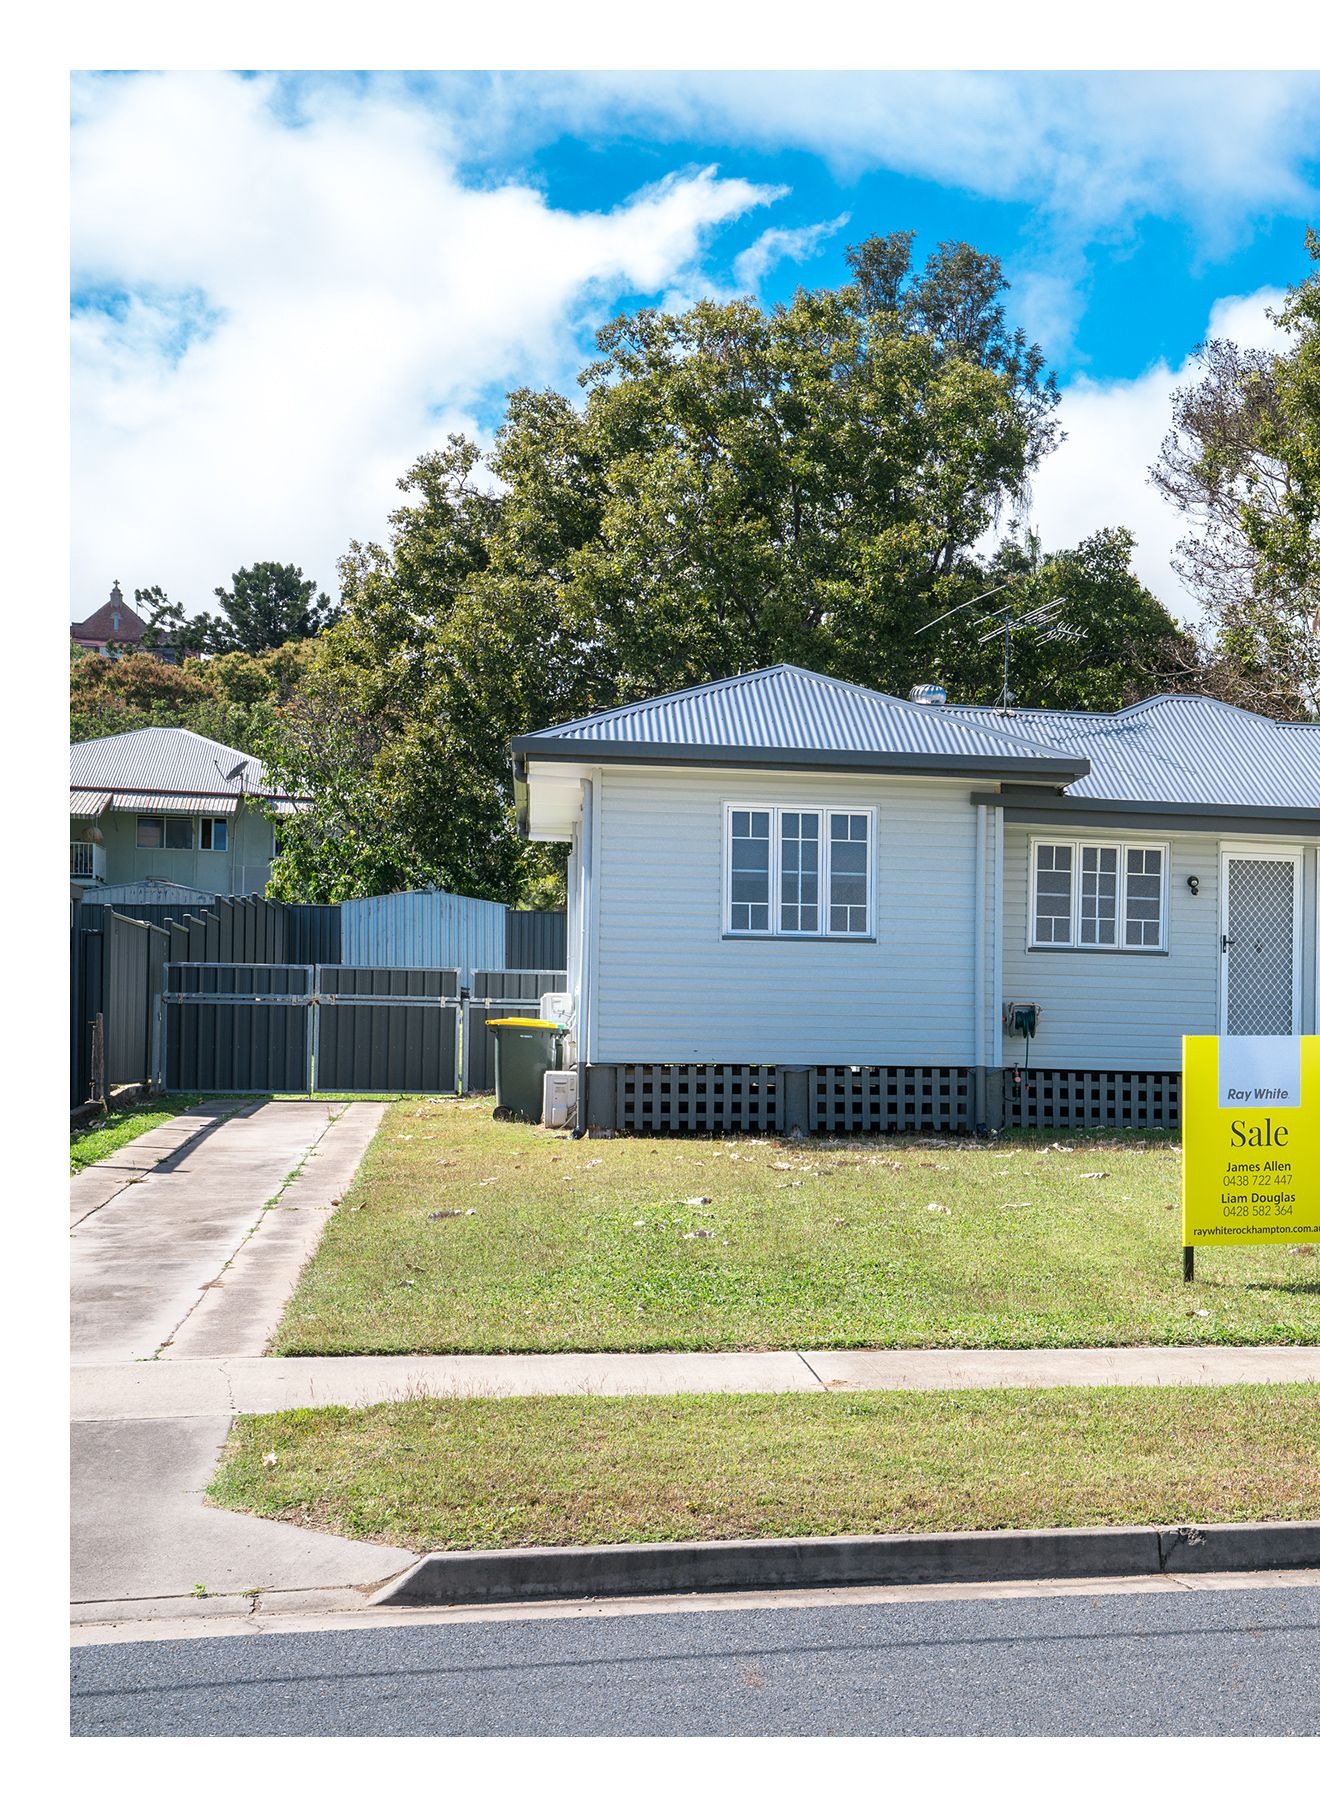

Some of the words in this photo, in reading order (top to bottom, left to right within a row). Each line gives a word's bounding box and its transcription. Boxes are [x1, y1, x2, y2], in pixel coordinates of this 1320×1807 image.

[1227, 1088, 1252, 1102] Ray
[1254, 1088, 1289, 1100] White
[1231, 1117, 1289, 1148] Sale
[1226, 1161, 1261, 1172] James
[1263, 1160, 1291, 1171] Allen
[1223, 1175, 1249, 1186] 0438
[1252, 1174, 1271, 1186] 722
[1273, 1174, 1293, 1185] 447
[1221, 1193, 1248, 1204] Liam
[1251, 1192, 1296, 1205] Douglas
[1223, 1206, 1249, 1217] 0428
[1252, 1205, 1272, 1216] 582
[1274, 1205, 1293, 1216] 364
